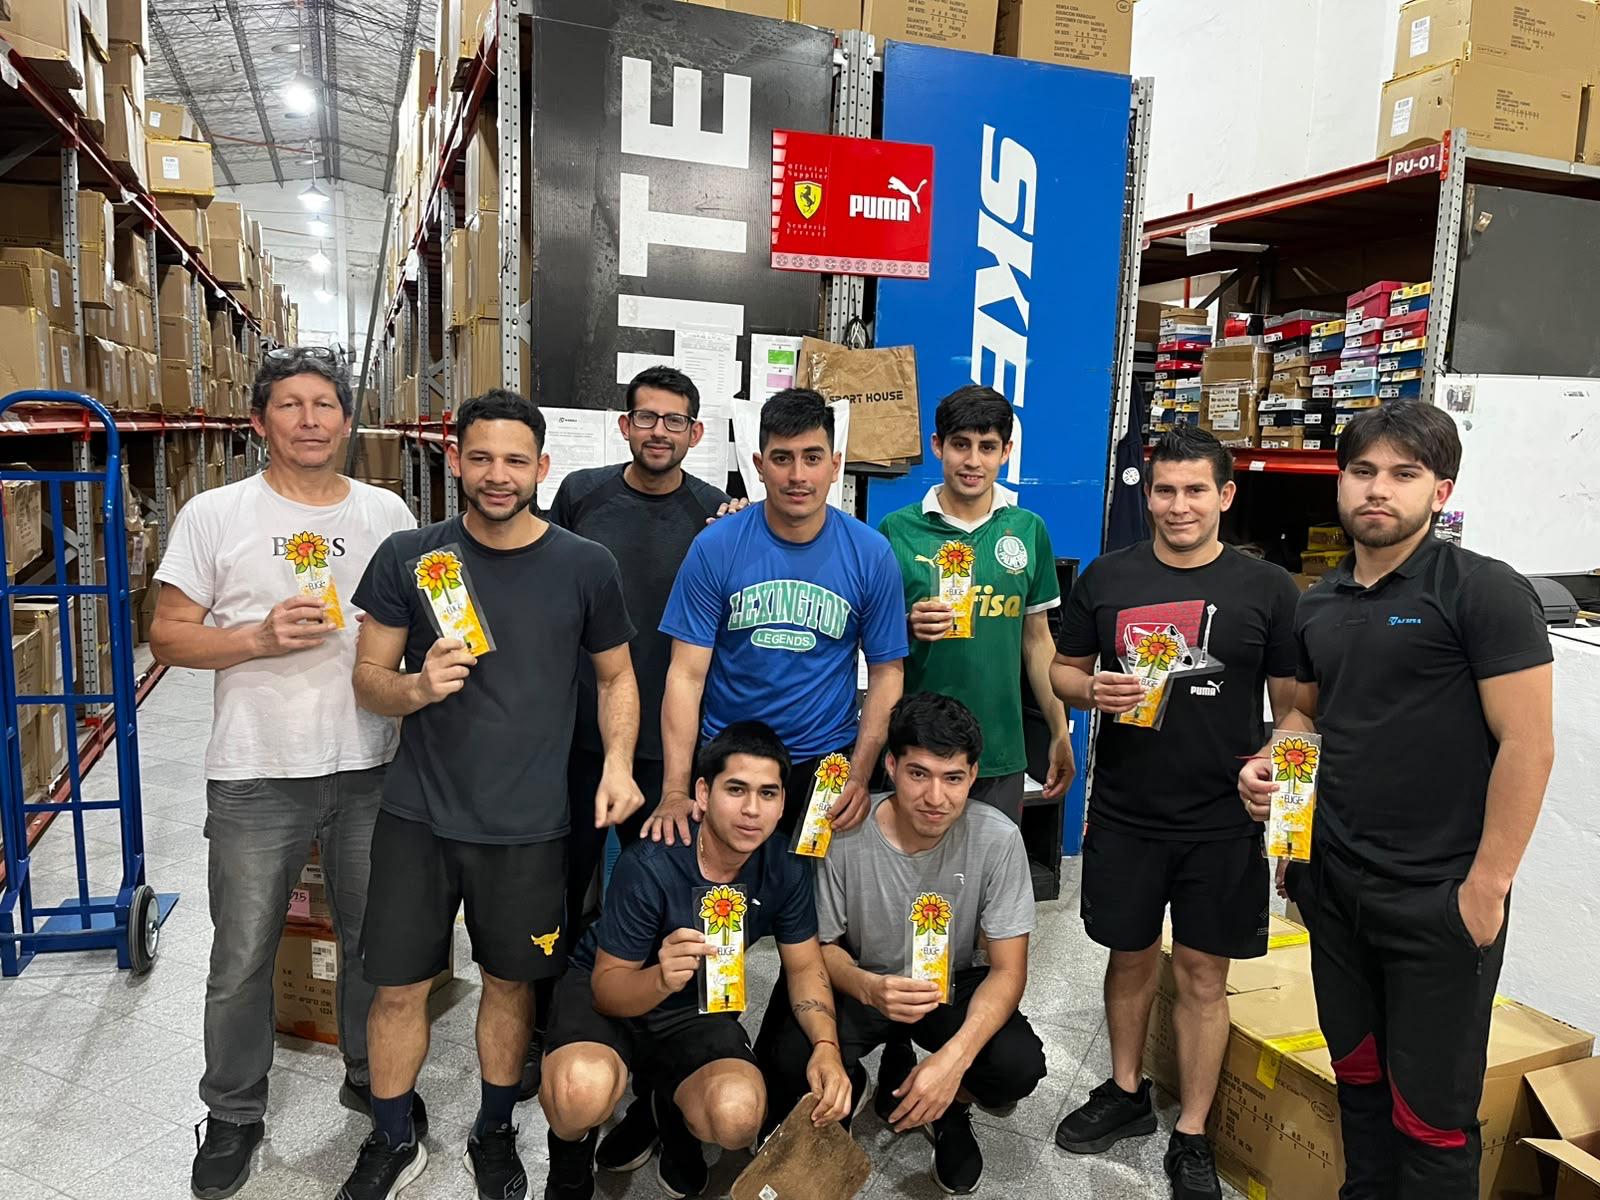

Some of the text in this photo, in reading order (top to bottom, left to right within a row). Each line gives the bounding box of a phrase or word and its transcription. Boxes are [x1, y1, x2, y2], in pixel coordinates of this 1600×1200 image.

[1395, 153, 1436, 176] PU-01
[787, 170, 829, 180] Supplier
[849, 194, 911, 222] PUMA
[786, 229, 827, 238] Ferrari
[866, 390, 904, 403] HOUSE
[272, 536, 346, 557] BS
[728, 580, 852, 640] LEXINGTON
[1190, 685, 1216, 697] PUMA
